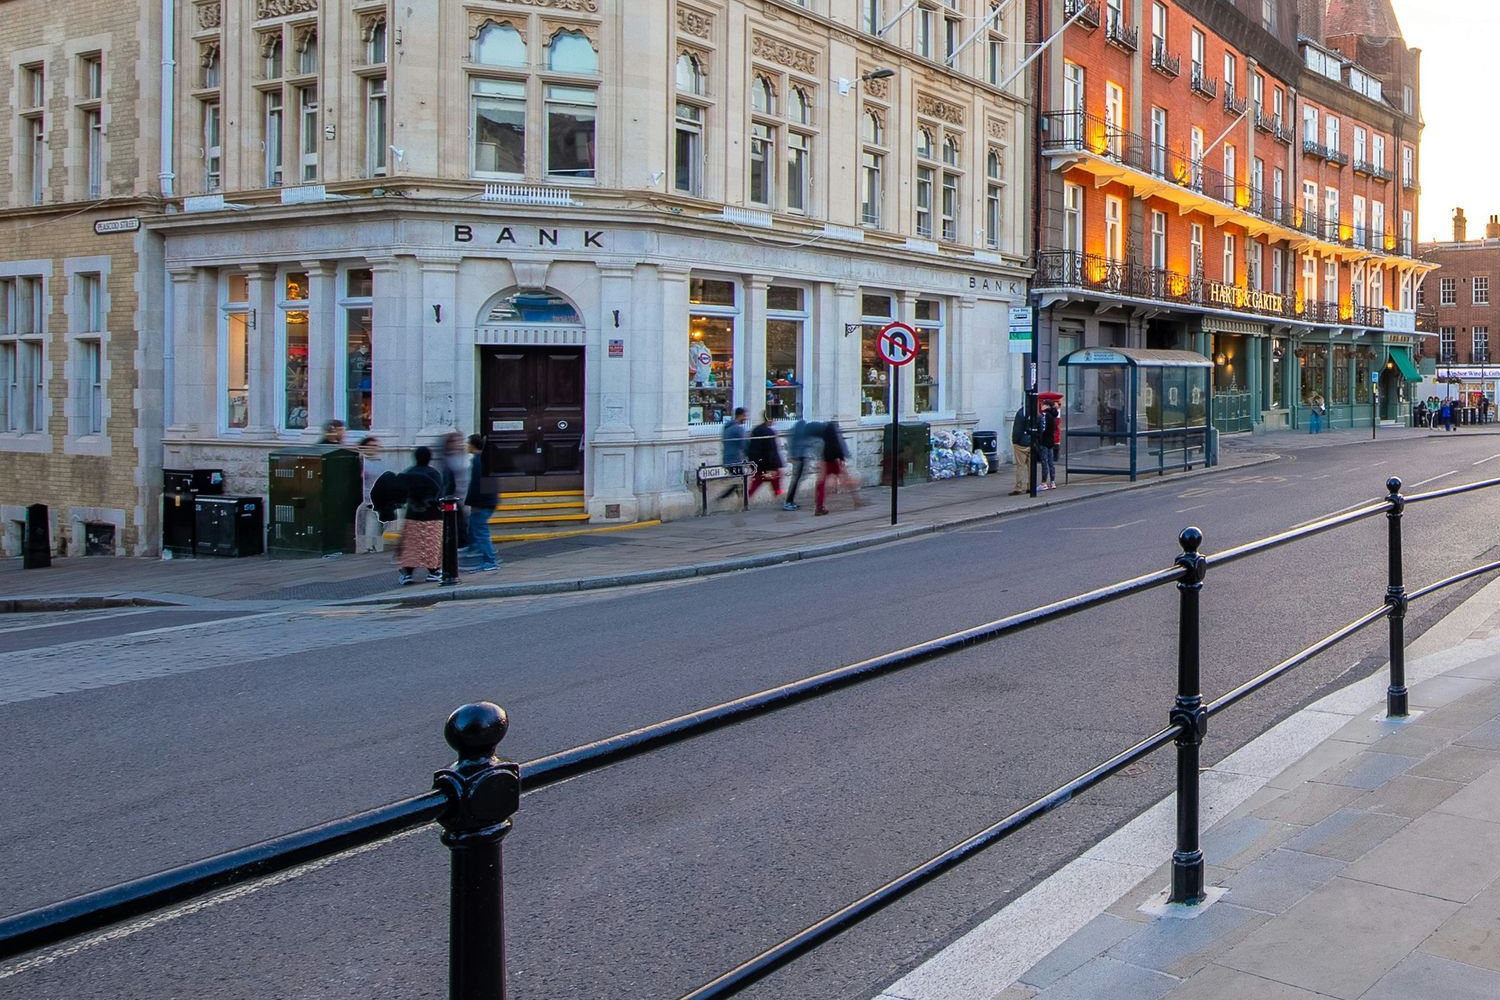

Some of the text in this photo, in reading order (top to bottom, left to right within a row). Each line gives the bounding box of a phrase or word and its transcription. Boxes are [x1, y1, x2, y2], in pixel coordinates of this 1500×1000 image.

[454, 224, 604, 248] BANK
[969, 276, 1016, 294] BANK
[1243, 290, 1252, 307] &
[1252, 291, 1283, 312] GARTER
[702, 464, 750, 478] HIGH STRE
